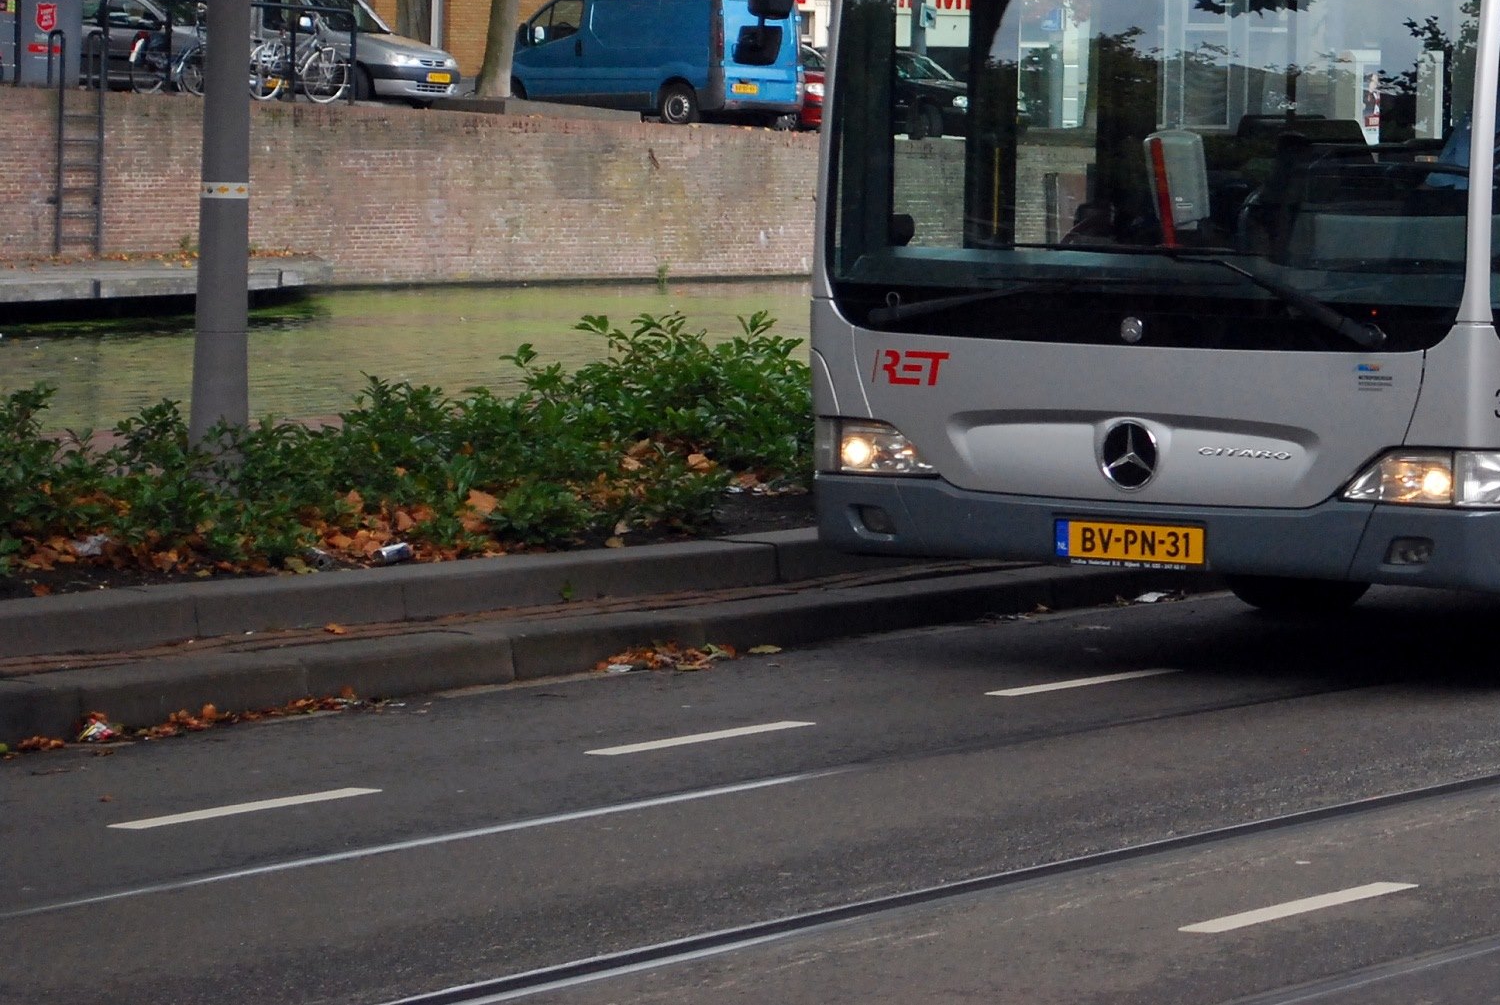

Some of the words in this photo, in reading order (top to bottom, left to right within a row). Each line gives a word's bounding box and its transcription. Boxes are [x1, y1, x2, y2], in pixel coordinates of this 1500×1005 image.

[872, 349, 950, 387] RET
[1197, 446, 1293, 461] CITARO
[1056, 541, 1067, 550] NL
[1081, 527, 1190, 558] BV-PN-31
